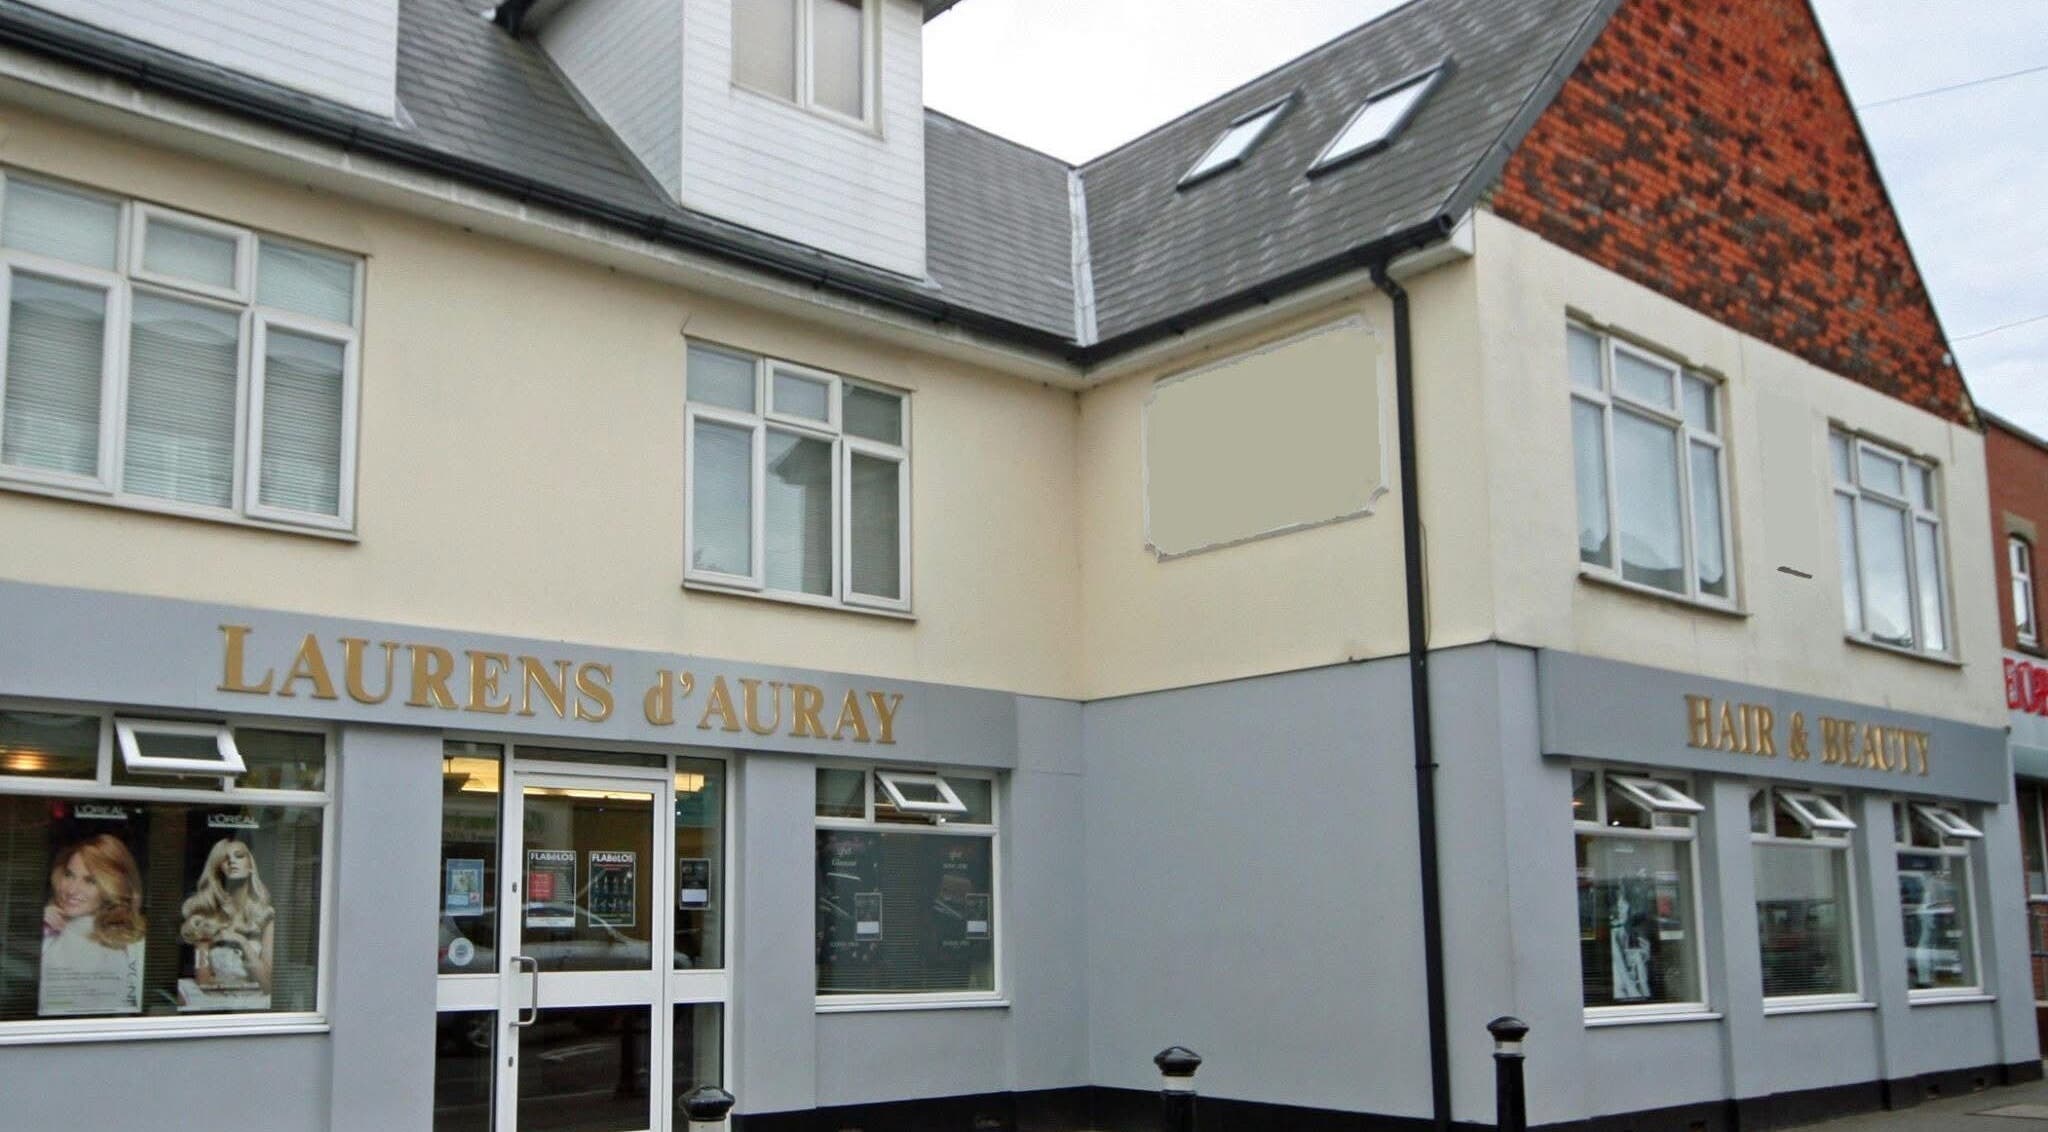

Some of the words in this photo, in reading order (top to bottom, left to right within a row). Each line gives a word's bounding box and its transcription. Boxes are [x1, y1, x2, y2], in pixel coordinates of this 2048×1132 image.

[217, 624, 614, 723] LAURENS
[643, 669, 904, 745] d'AURAY
[1684, 694, 1777, 757] HAIR
[1787, 711, 1810, 762] &
[1818, 715, 1931, 777] BEAUTY
